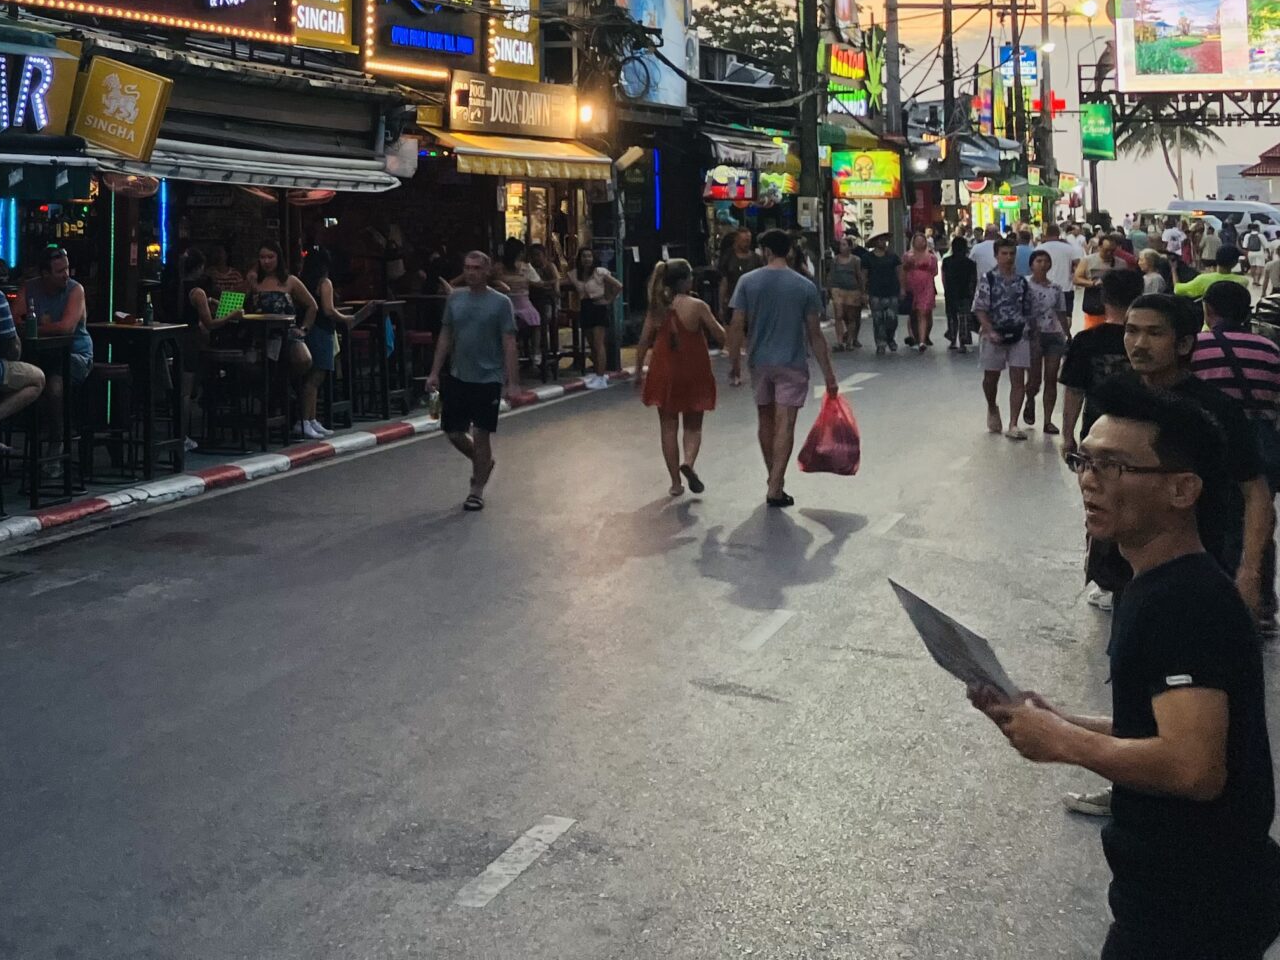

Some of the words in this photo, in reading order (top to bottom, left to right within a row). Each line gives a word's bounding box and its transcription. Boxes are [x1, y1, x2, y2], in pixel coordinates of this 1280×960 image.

[297, 4, 345, 35] SINGHA
[494, 36, 534, 66] SINGHA
[490, 86, 520, 124] DUSK
[84, 114, 136, 142] SINGHA
